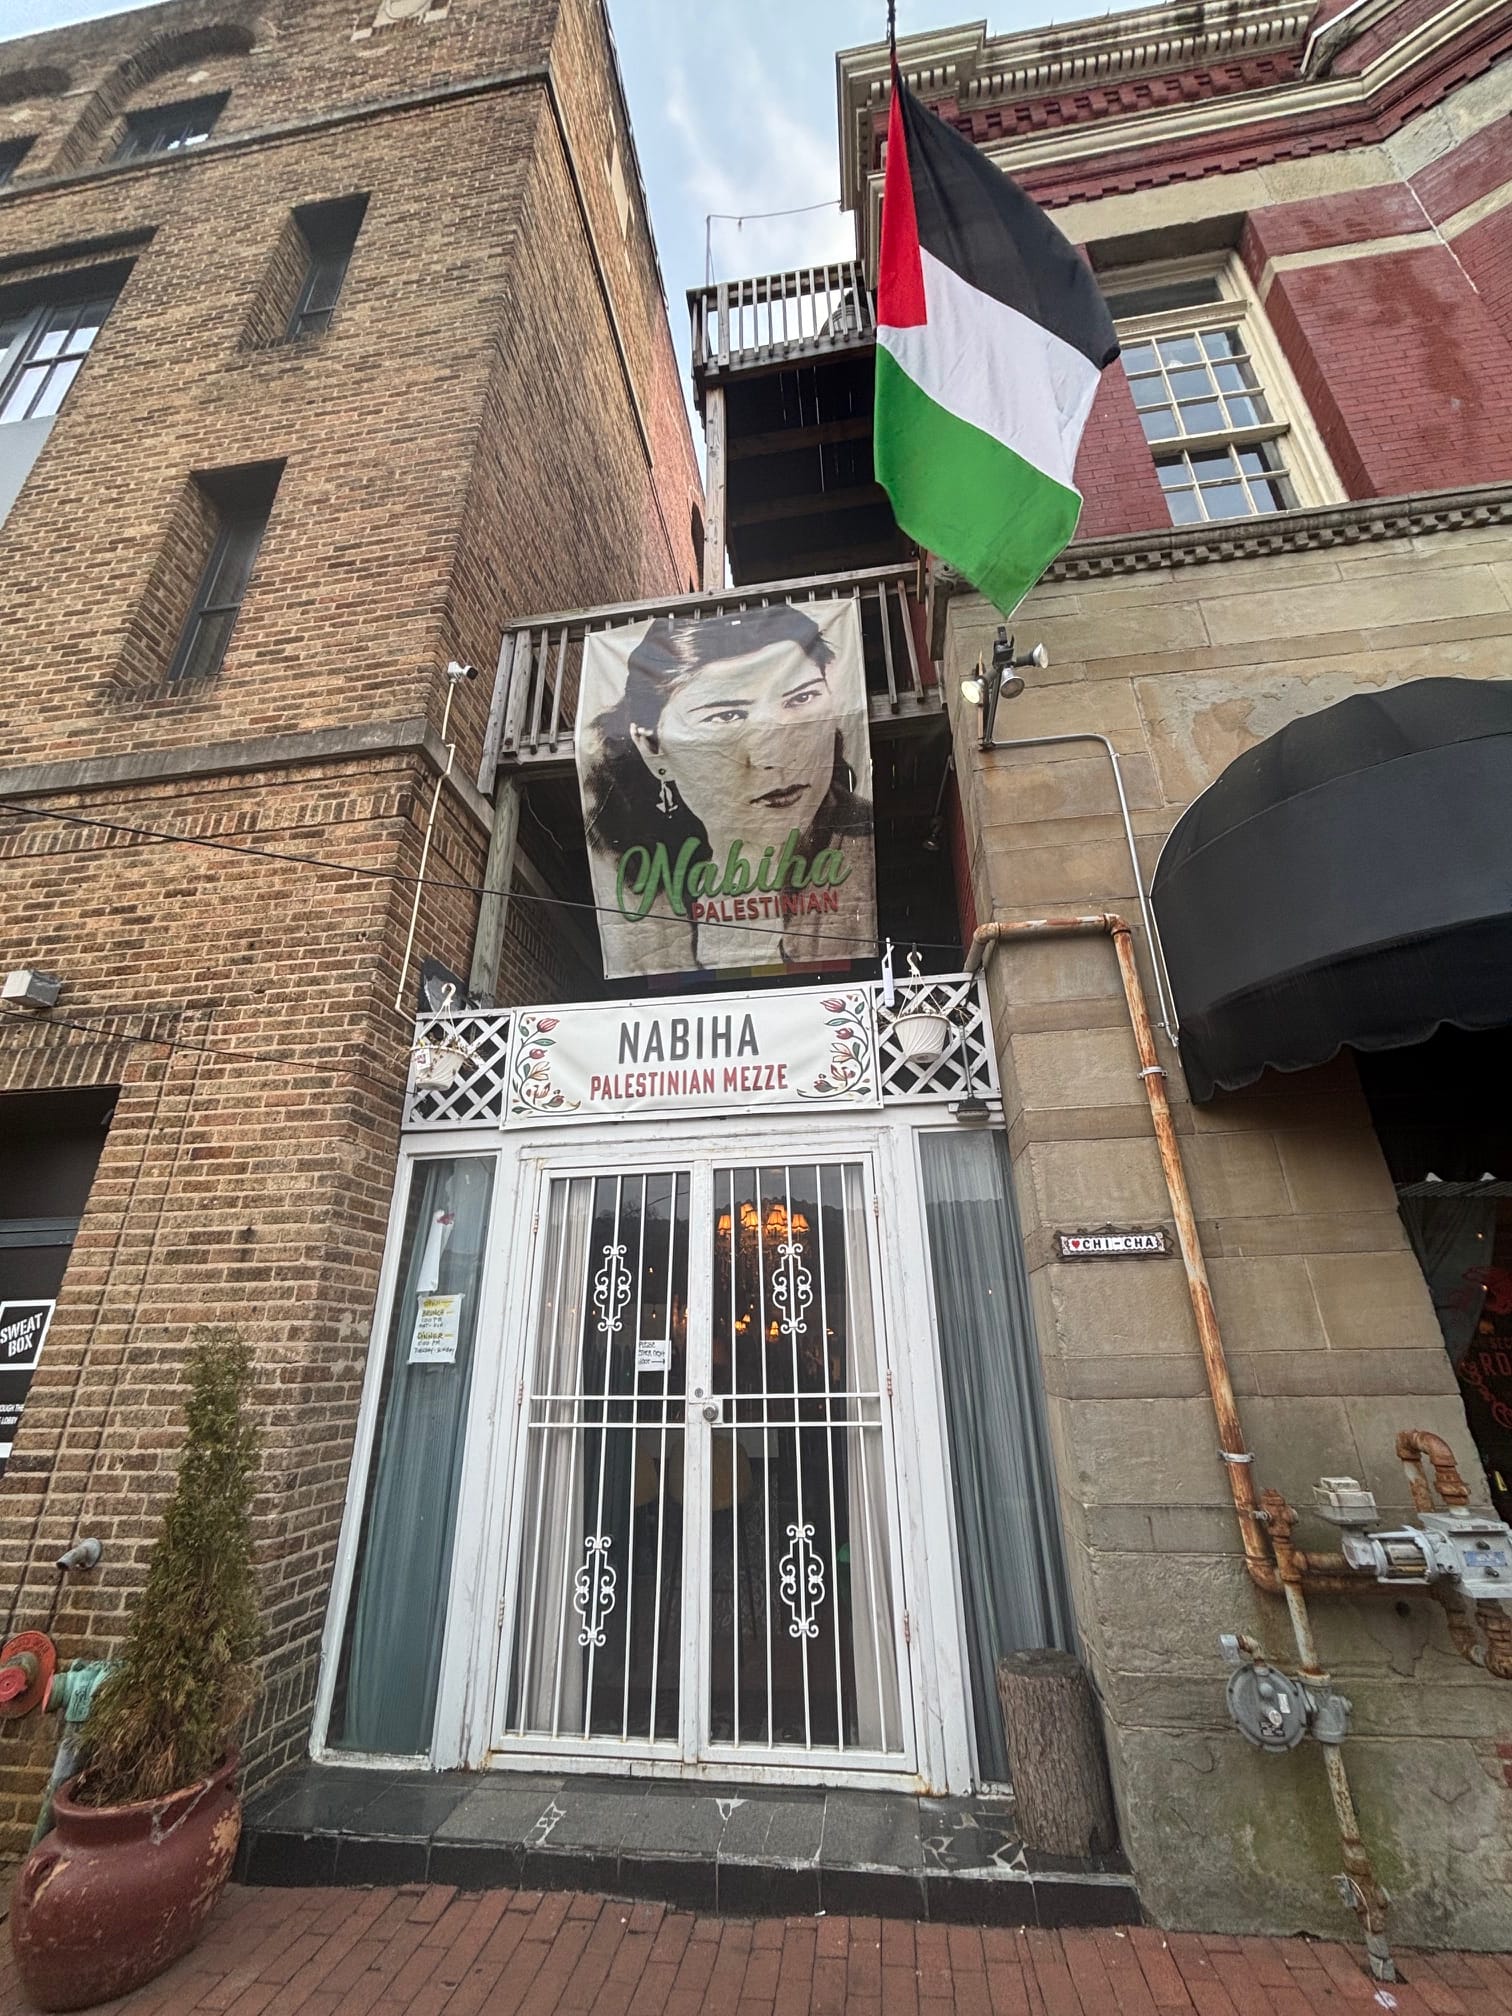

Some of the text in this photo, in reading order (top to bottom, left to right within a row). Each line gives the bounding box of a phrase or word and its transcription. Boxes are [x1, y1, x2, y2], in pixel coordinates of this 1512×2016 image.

[616, 828, 852, 922] Nabiha
[691, 890, 839, 922] PALESTINIAN
[618, 1013, 760, 1065] NABIHA
[590, 1063, 788, 1101] PALESTINIAN MEZZE
[0, 1312, 43, 1344] SWEAT
[8, 1332, 33, 1357] BOX
